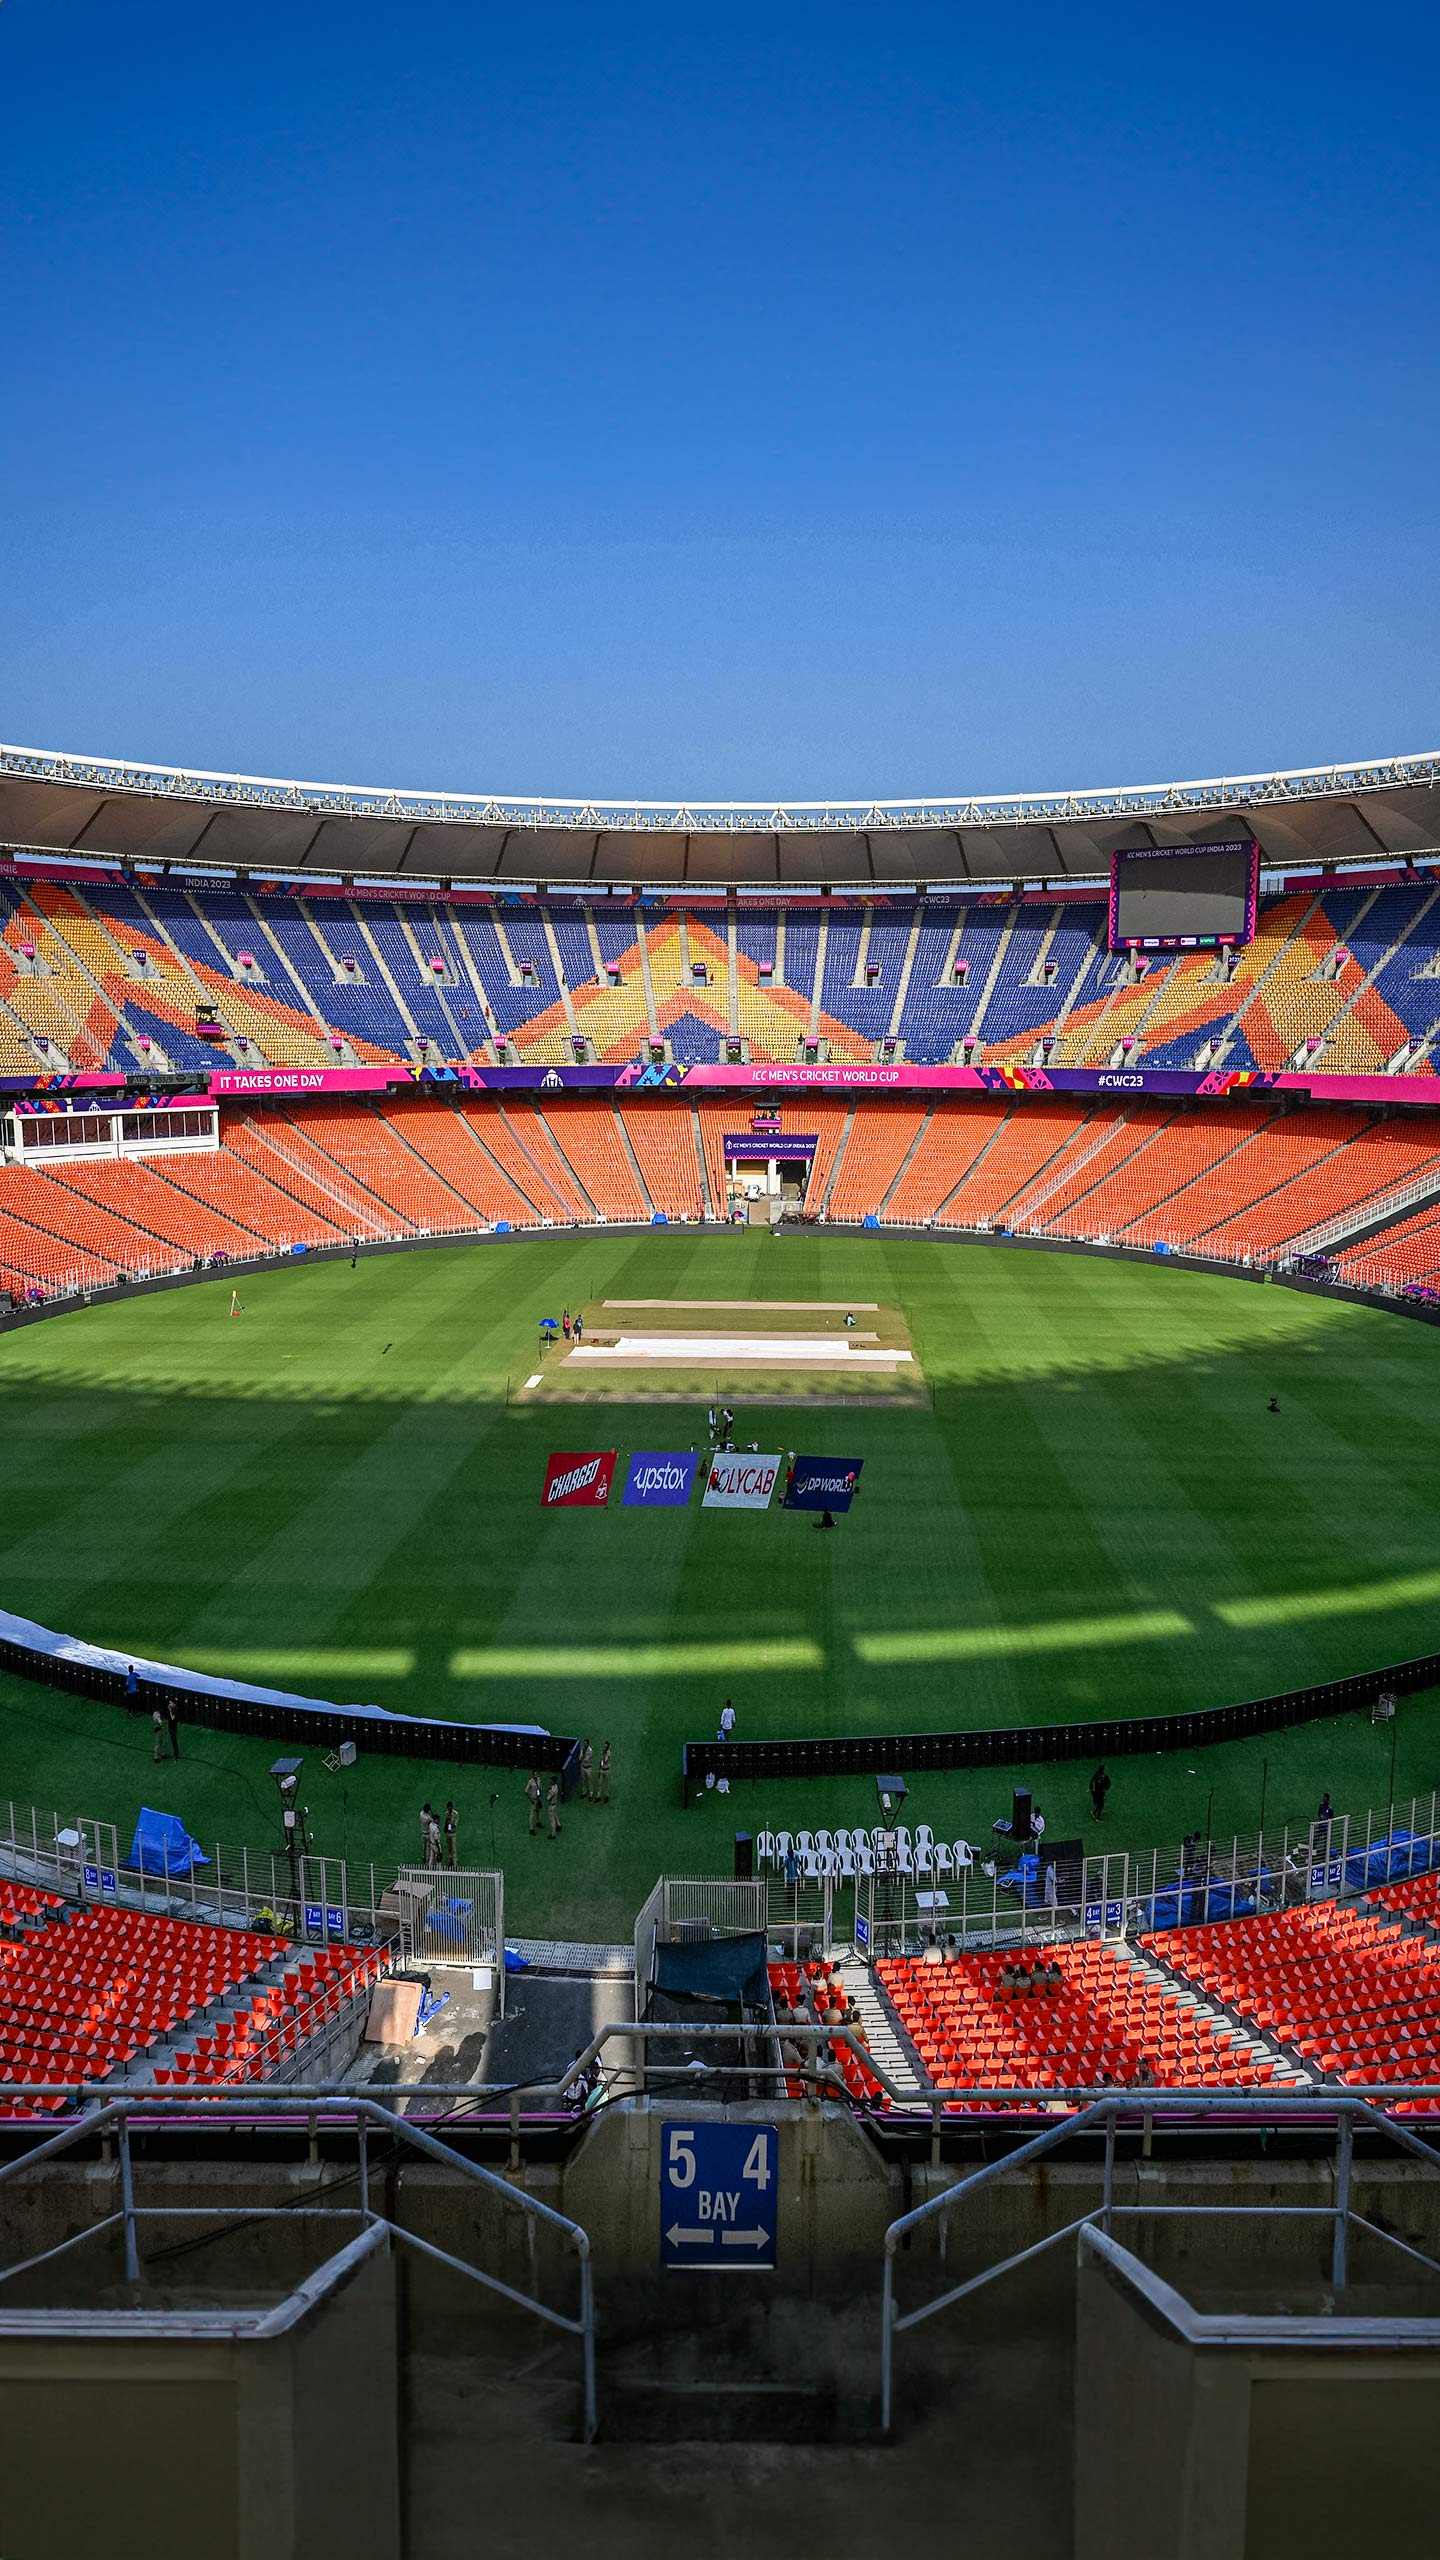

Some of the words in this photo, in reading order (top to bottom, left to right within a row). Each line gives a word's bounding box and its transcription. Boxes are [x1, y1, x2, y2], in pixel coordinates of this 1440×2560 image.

[185, 878, 209, 887] INDIA
[210, 880, 230, 888] 2023
[345, 888, 356, 896] ICC
[357, 889, 377, 897] MEN'S
[378, 890, 408, 898] CRICKET
[220, 1076, 231, 1088] IT
[234, 1076, 272, 1088] TAKES
[274, 1075, 298, 1087] ONE
[301, 1075, 324, 1086] DAY
[752, 1071, 767, 1080] ICC
[768, 1070, 798, 1080] MEN'S
[800, 1071, 840, 1081] CRICKET
[842, 1071, 878, 1082] WORLD
[879, 1071, 899, 1082] CUP
[1098, 1075, 1144, 1086] #CWC23
[548, 1457, 602, 1502] CHARGED
[634, 1462, 688, 1497] upstox
[807, 1477, 821, 1491] DP
[86, 1868, 90, 1880] 8
[1312, 1869, 1317, 1880] 3
[1336, 1864, 1340, 1876] 2
[109, 1874, 113, 1885] 7
[307, 1908, 312, 1919] 7
[1087, 1908, 1092, 1918] 4
[1115, 1903, 1120, 1915] 3
[336, 1911, 341, 1923] 6
[668, 2130, 696, 2189] 5
[742, 2134, 771, 2190] 4
[698, 2190, 741, 2221] BAY
